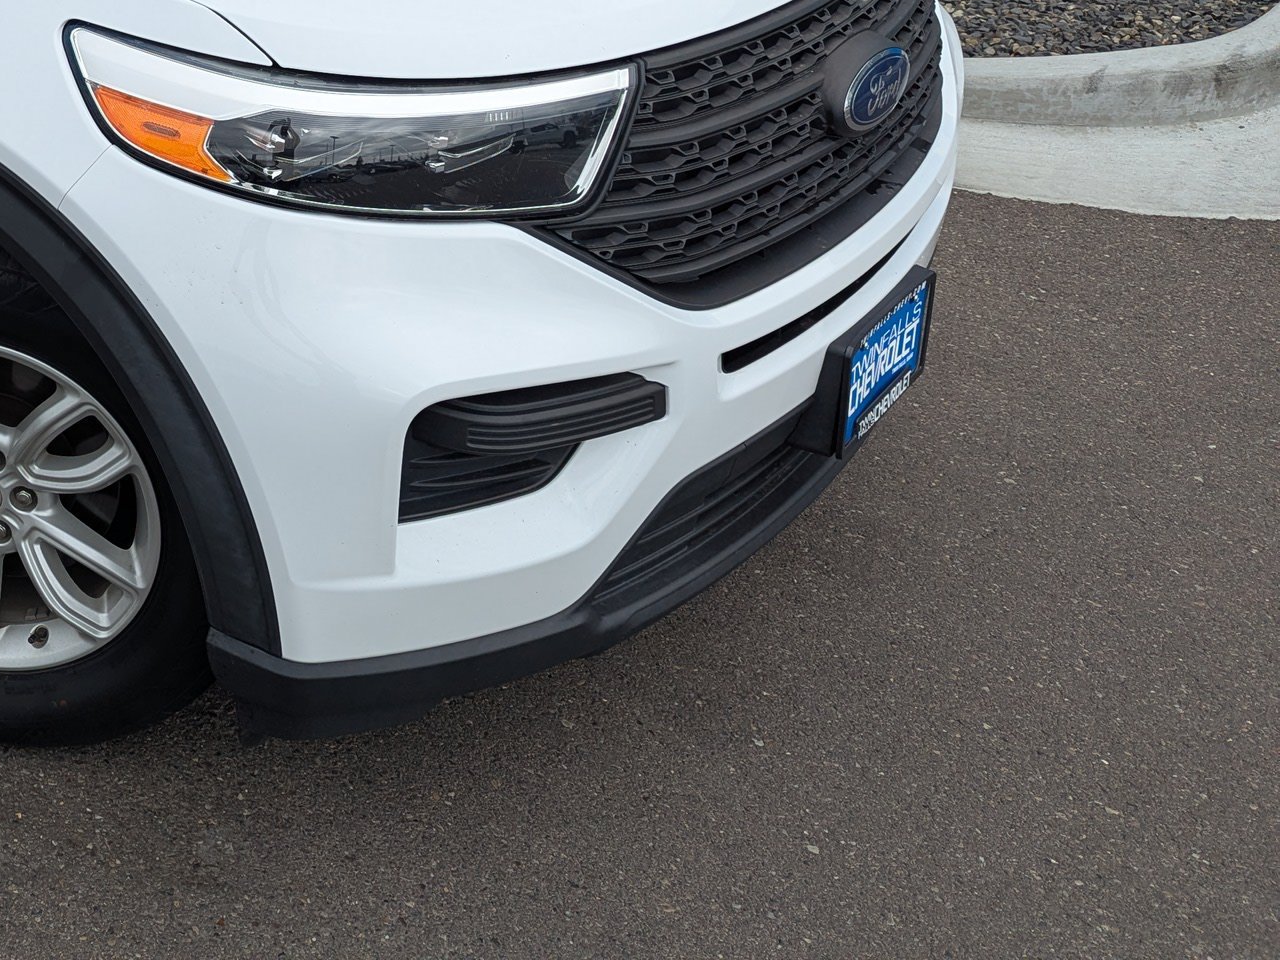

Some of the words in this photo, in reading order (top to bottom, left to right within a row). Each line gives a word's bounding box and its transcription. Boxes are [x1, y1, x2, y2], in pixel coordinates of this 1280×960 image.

[867, 66, 901, 116] Ford
[848, 318, 920, 417] CHEVROLET
[851, 301, 922, 383] TWINFALLS
[873, 370, 911, 421] CHEVROLET
